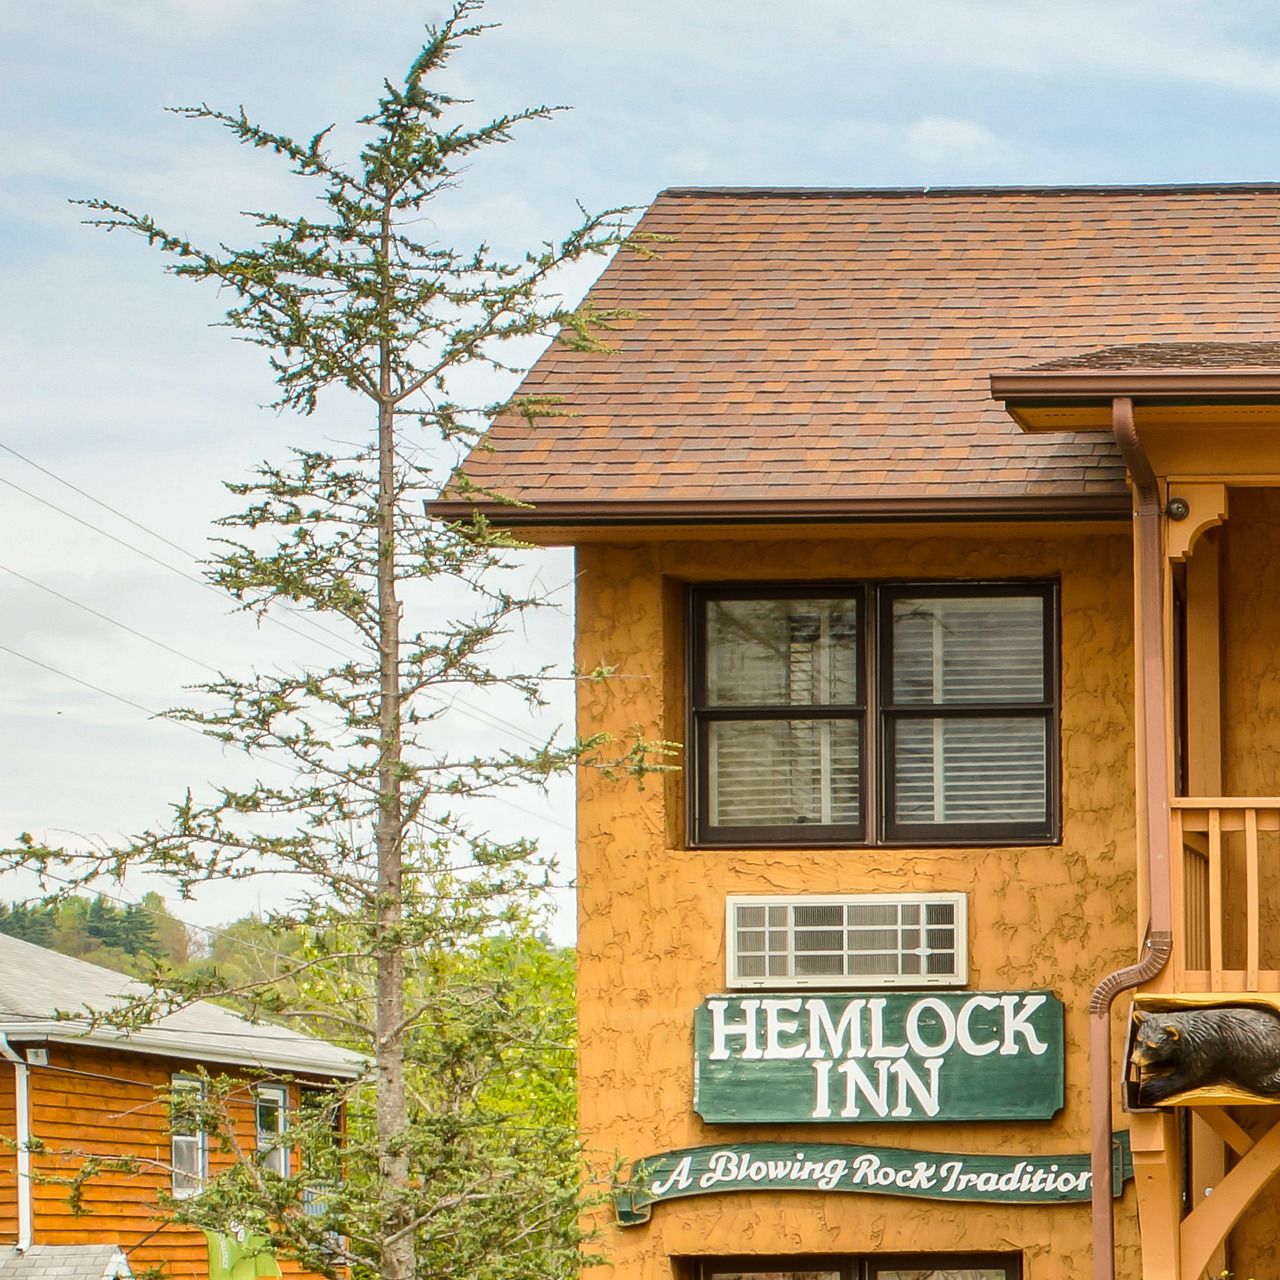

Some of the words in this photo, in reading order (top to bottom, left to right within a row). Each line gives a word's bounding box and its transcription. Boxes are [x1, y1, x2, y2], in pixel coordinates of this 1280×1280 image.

[707, 994, 1048, 1060] HEMLOCK
[811, 1058, 945, 1118] INN
[651, 1156, 693, 1194] A
[700, 1151, 848, 1190] Blowing
